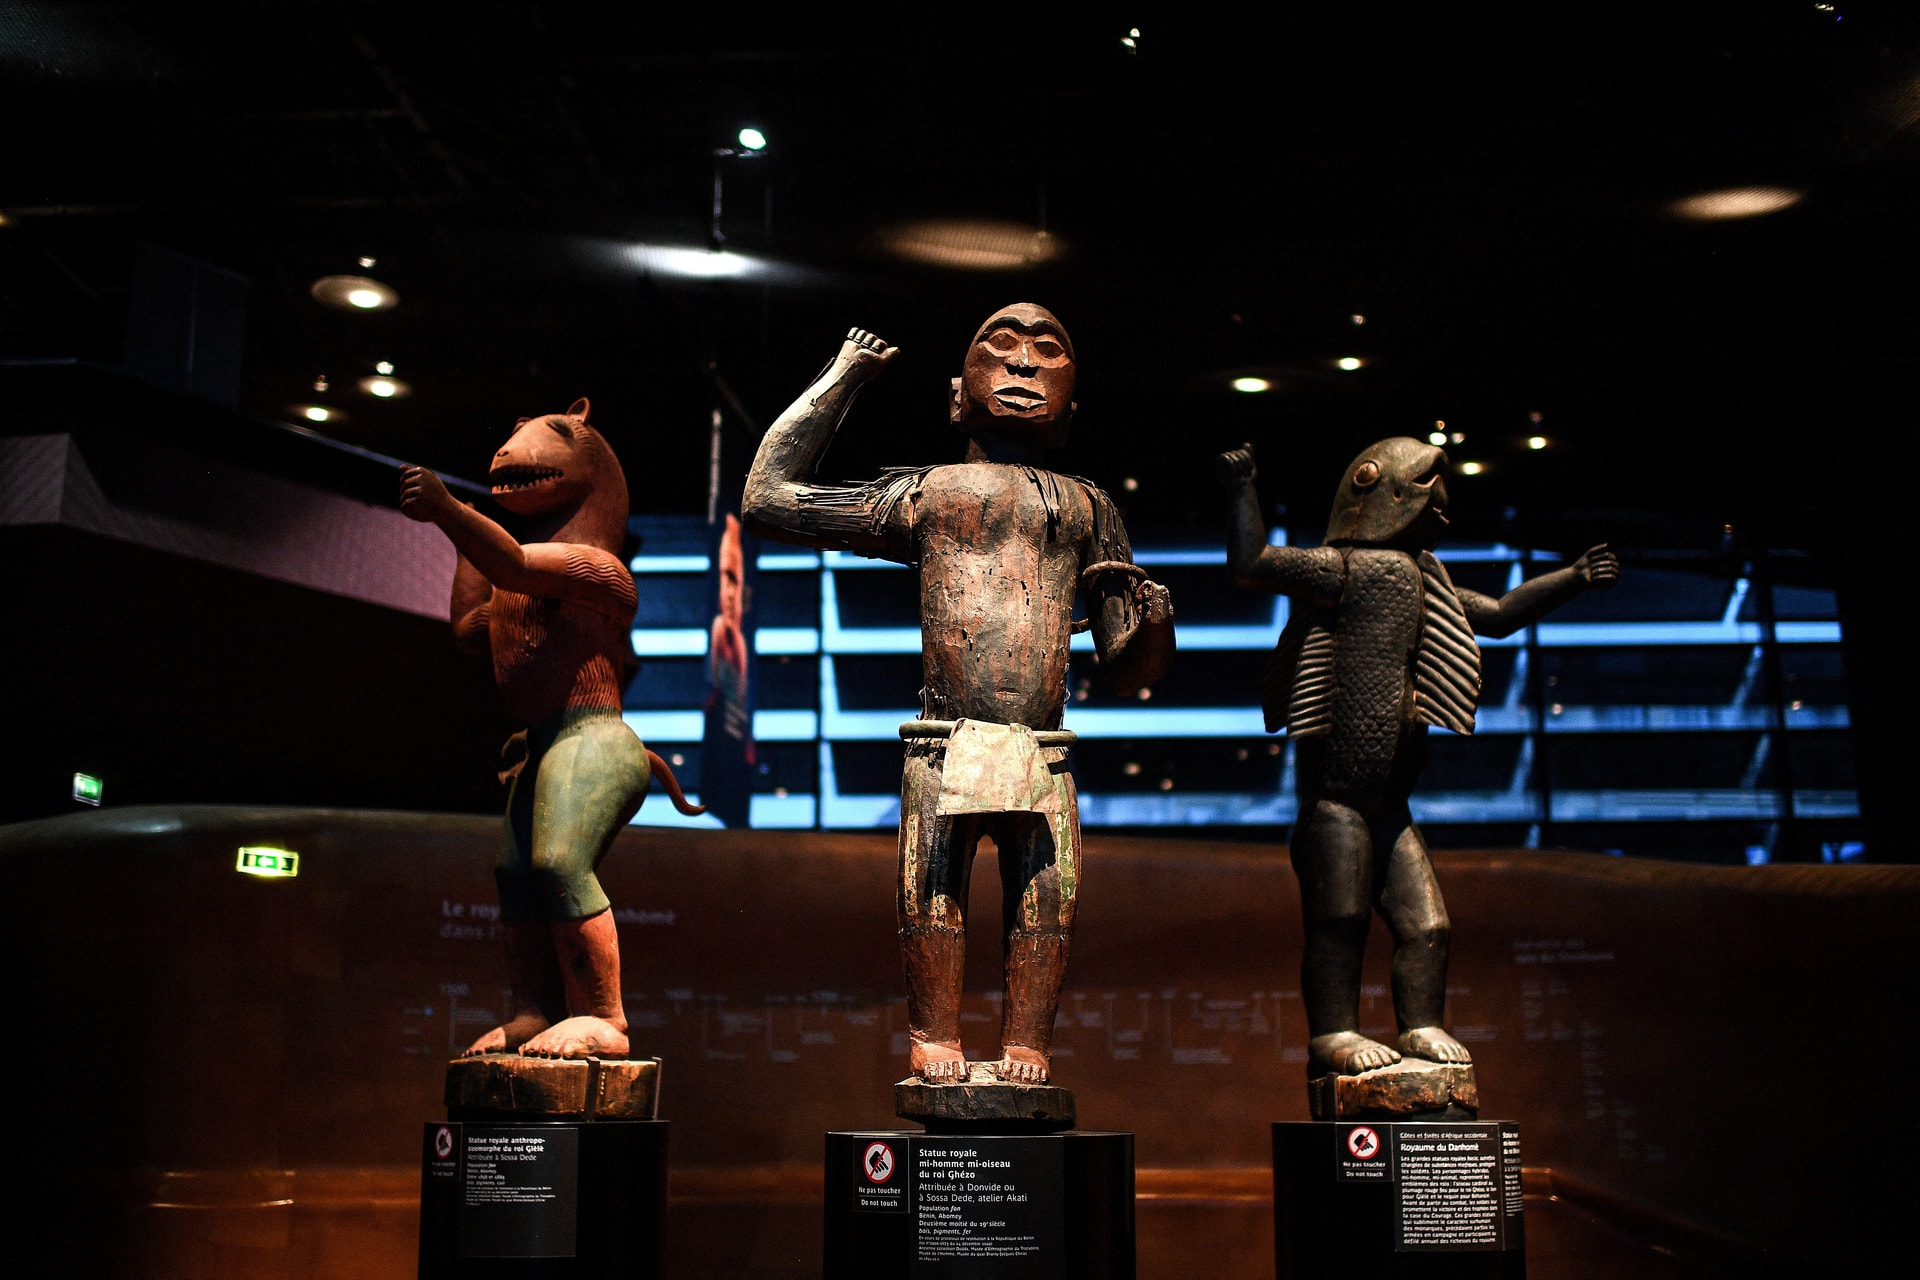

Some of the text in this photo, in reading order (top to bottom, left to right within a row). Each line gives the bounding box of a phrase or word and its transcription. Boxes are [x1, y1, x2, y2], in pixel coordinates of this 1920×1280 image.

[488, 1137, 509, 1145] royale
[510, 1137, 545, 1145] anthropo-
[1400, 1143, 1435, 1152] Royaume
[1436, 1143, 1446, 1151] du
[919, 1149, 977, 1158] Statue royale
[919, 1160, 1010, 1168] mi-homme mi-oiseau
[919, 1170, 975, 1180] du roi Ghézo
[919, 1182, 956, 1191] Attribuée
[959, 1182, 964, 1191] à
[967, 1183, 1001, 1191] Donvide
[919, 1193, 1028, 1203] à Sossa Dede, atelier Akati
